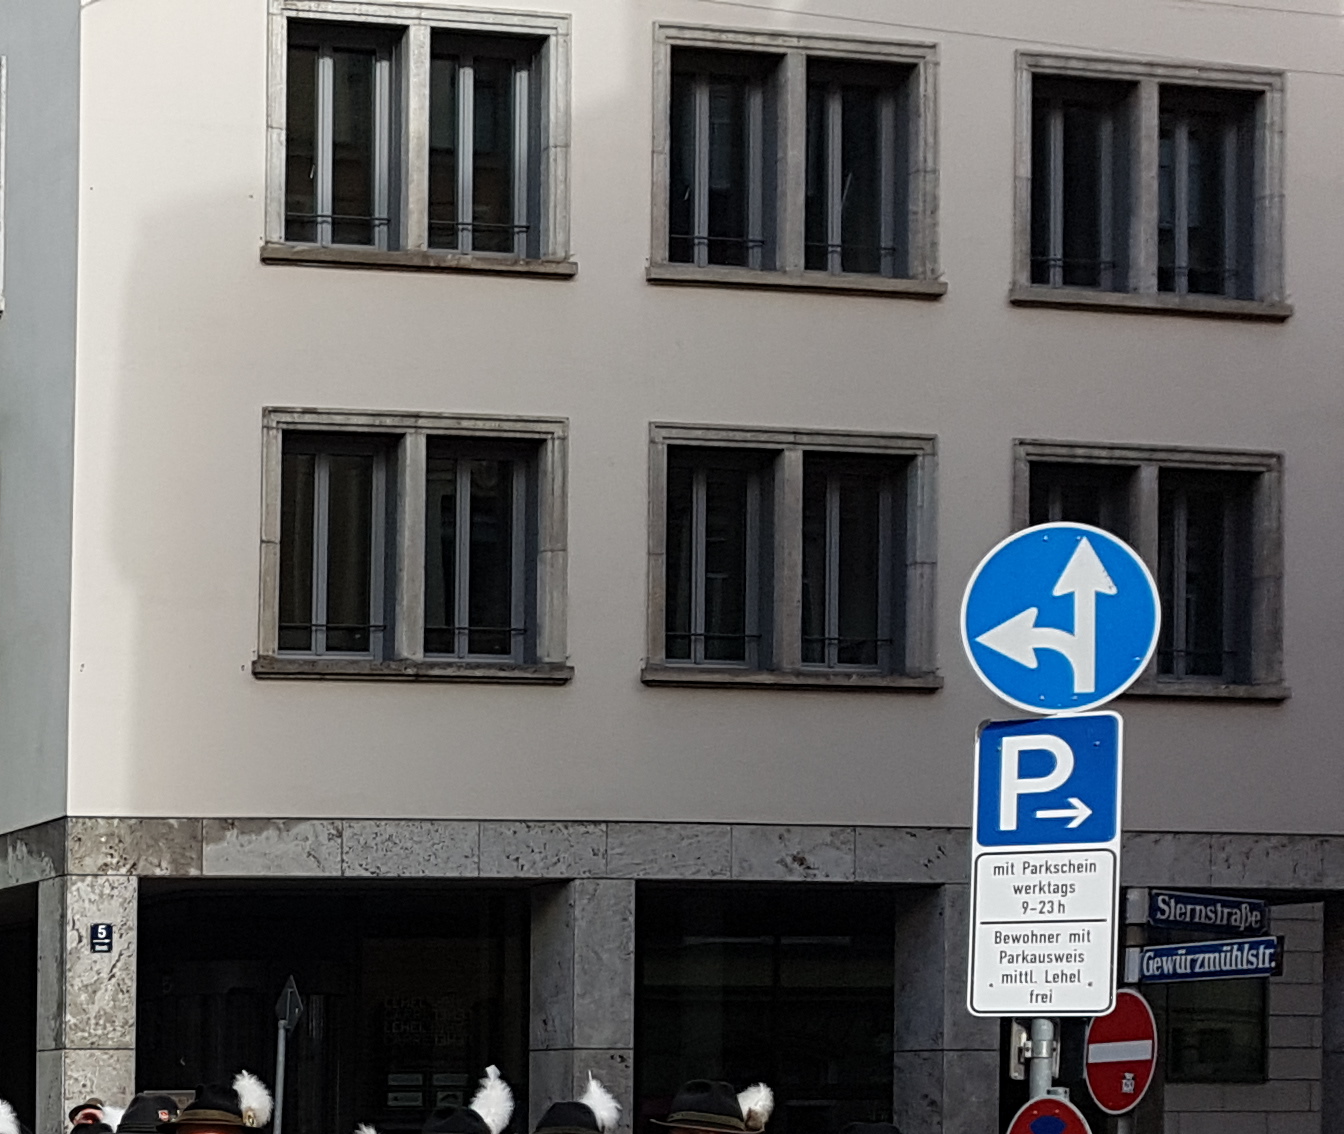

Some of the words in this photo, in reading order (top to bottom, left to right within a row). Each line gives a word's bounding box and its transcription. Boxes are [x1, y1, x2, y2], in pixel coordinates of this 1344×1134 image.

[999, 733, 1075, 832] P
[993, 861, 1016, 876] mit
[1022, 858, 1097, 876] Parkschein
[1012, 880, 1076, 898] werktags
[1057, 899, 1066, 914] h
[1156, 895, 1261, 931] Sternstraße
[97, 925, 107, 938] 5
[994, 929, 1062, 945] Bewohner
[1068, 928, 1091, 944] mit
[999, 948, 1085, 965] Parkausweis
[1142, 944, 1276, 976] Gewürzmühlstr.
[1001, 969, 1038, 984] mittl.
[1044, 968, 1081, 984] Lehel
[1029, 989, 1053, 1004] frei
